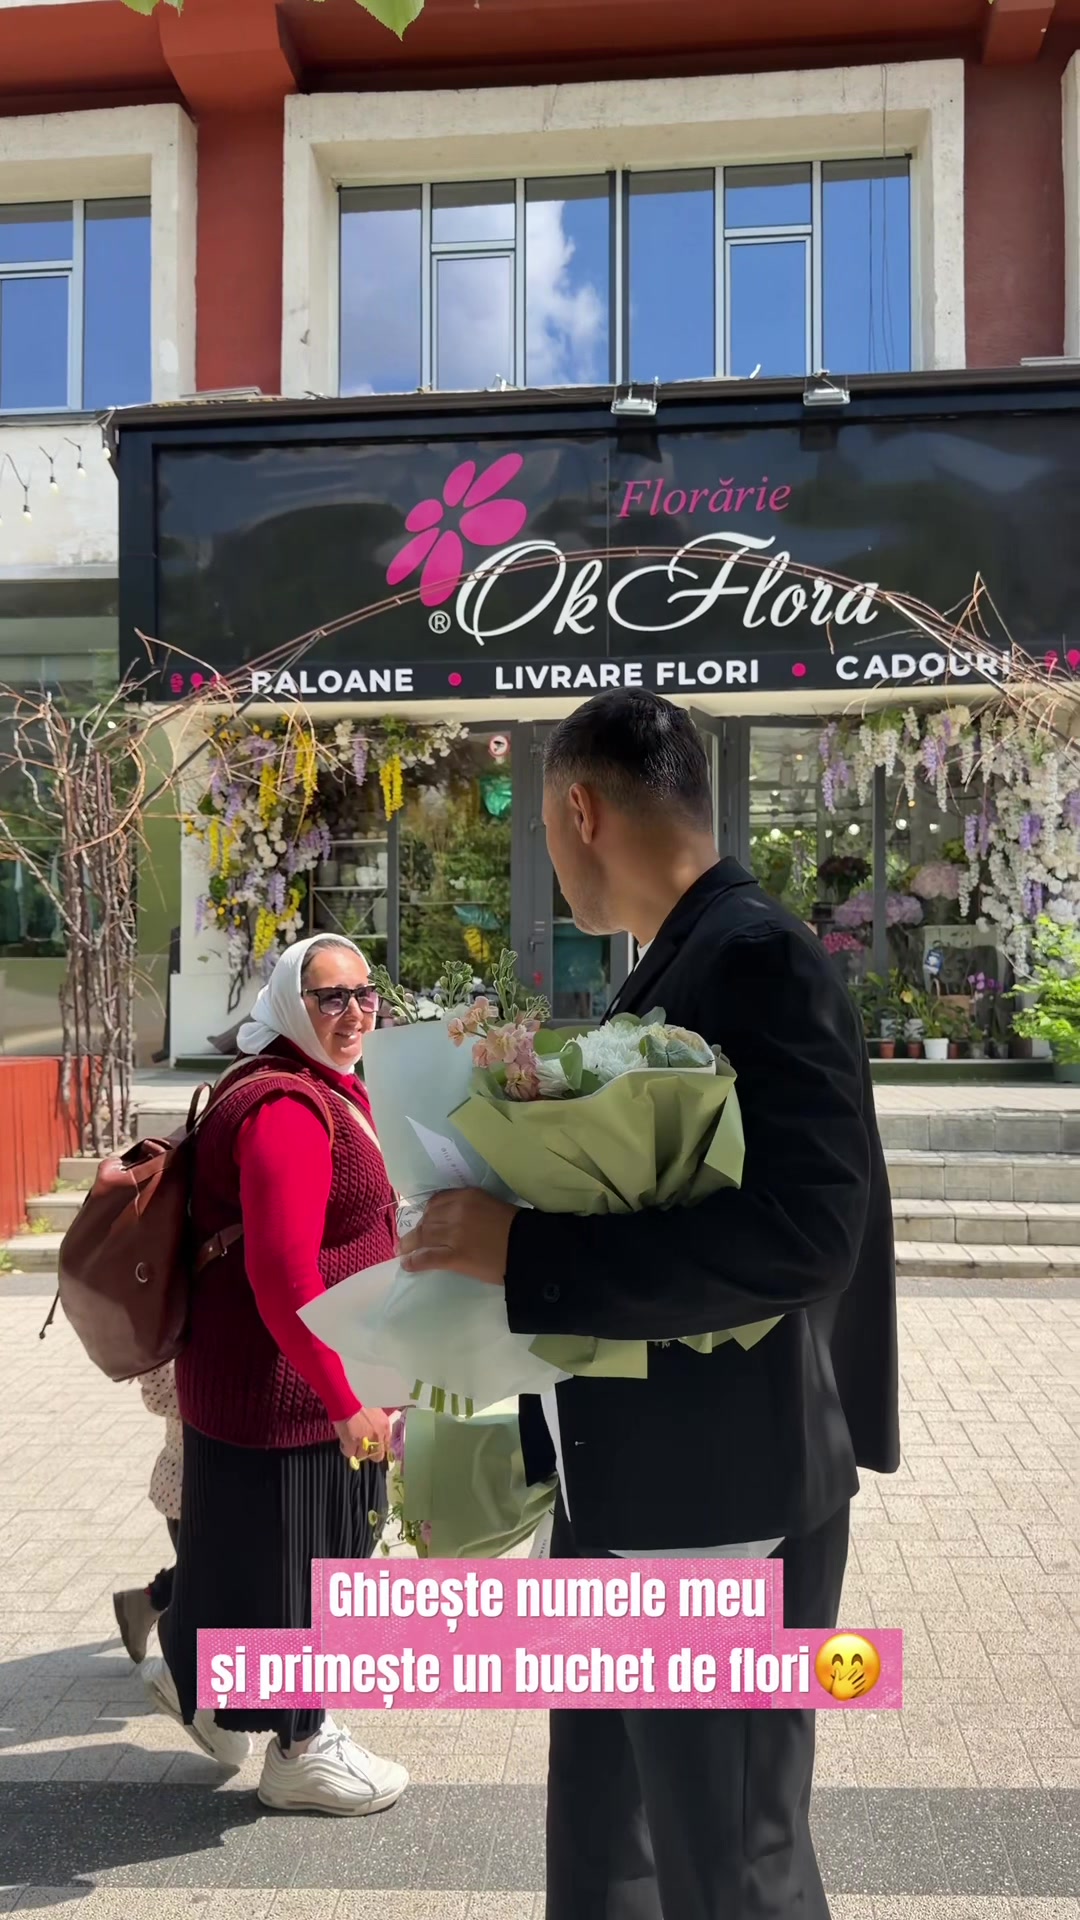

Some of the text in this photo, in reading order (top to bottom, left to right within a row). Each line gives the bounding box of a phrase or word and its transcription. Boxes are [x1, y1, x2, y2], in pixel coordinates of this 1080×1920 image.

[617, 476, 793, 519] Florărie
[455, 539, 603, 646] Ok
[607, 531, 880, 633] Flora
[251, 667, 414, 695] BALOANE
[495, 662, 643, 690] LIVRARE
[656, 659, 759, 686] FLORI
